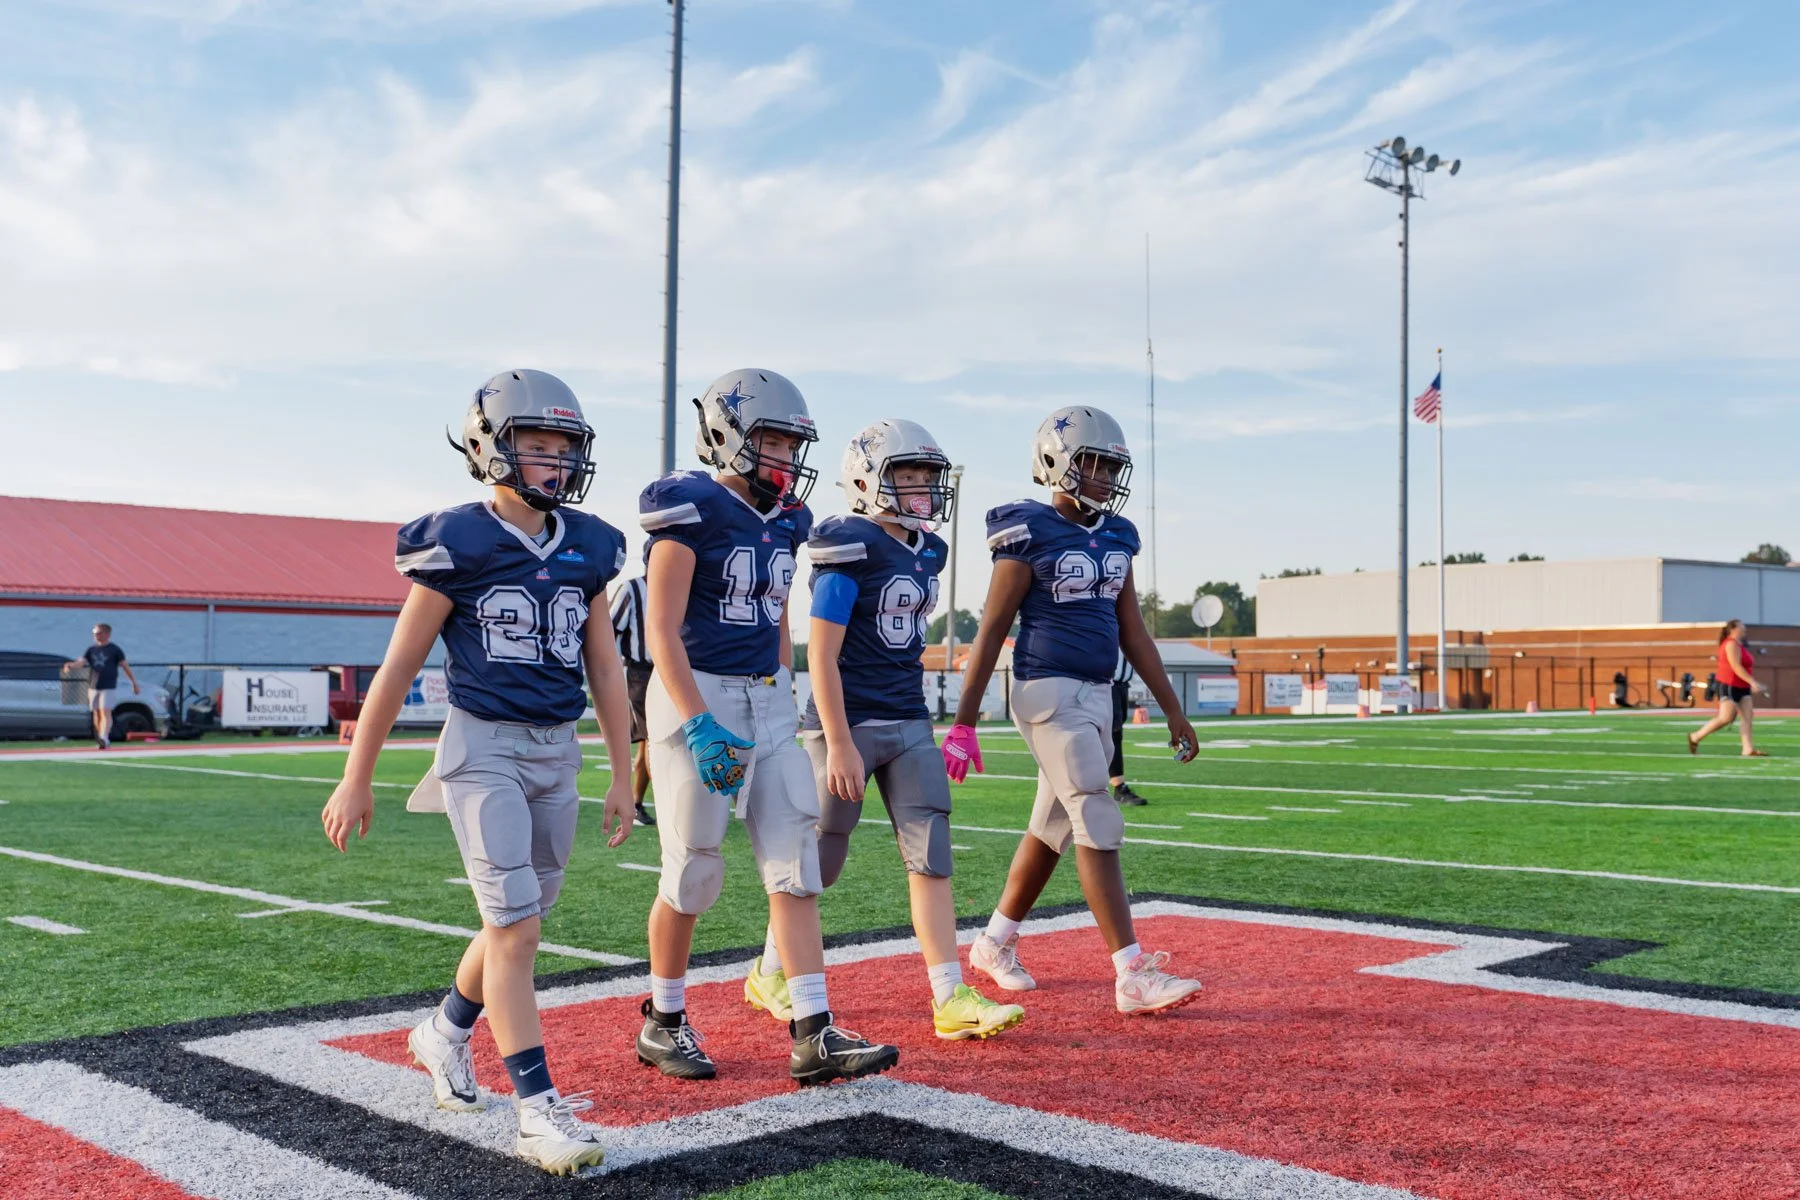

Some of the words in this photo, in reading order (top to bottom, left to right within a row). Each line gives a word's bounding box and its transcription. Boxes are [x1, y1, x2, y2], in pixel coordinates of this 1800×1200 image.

[1052, 550, 1132, 604] 22
[246, 678, 295, 699] HOUSE
[246, 694, 309, 713] INSURANCE
